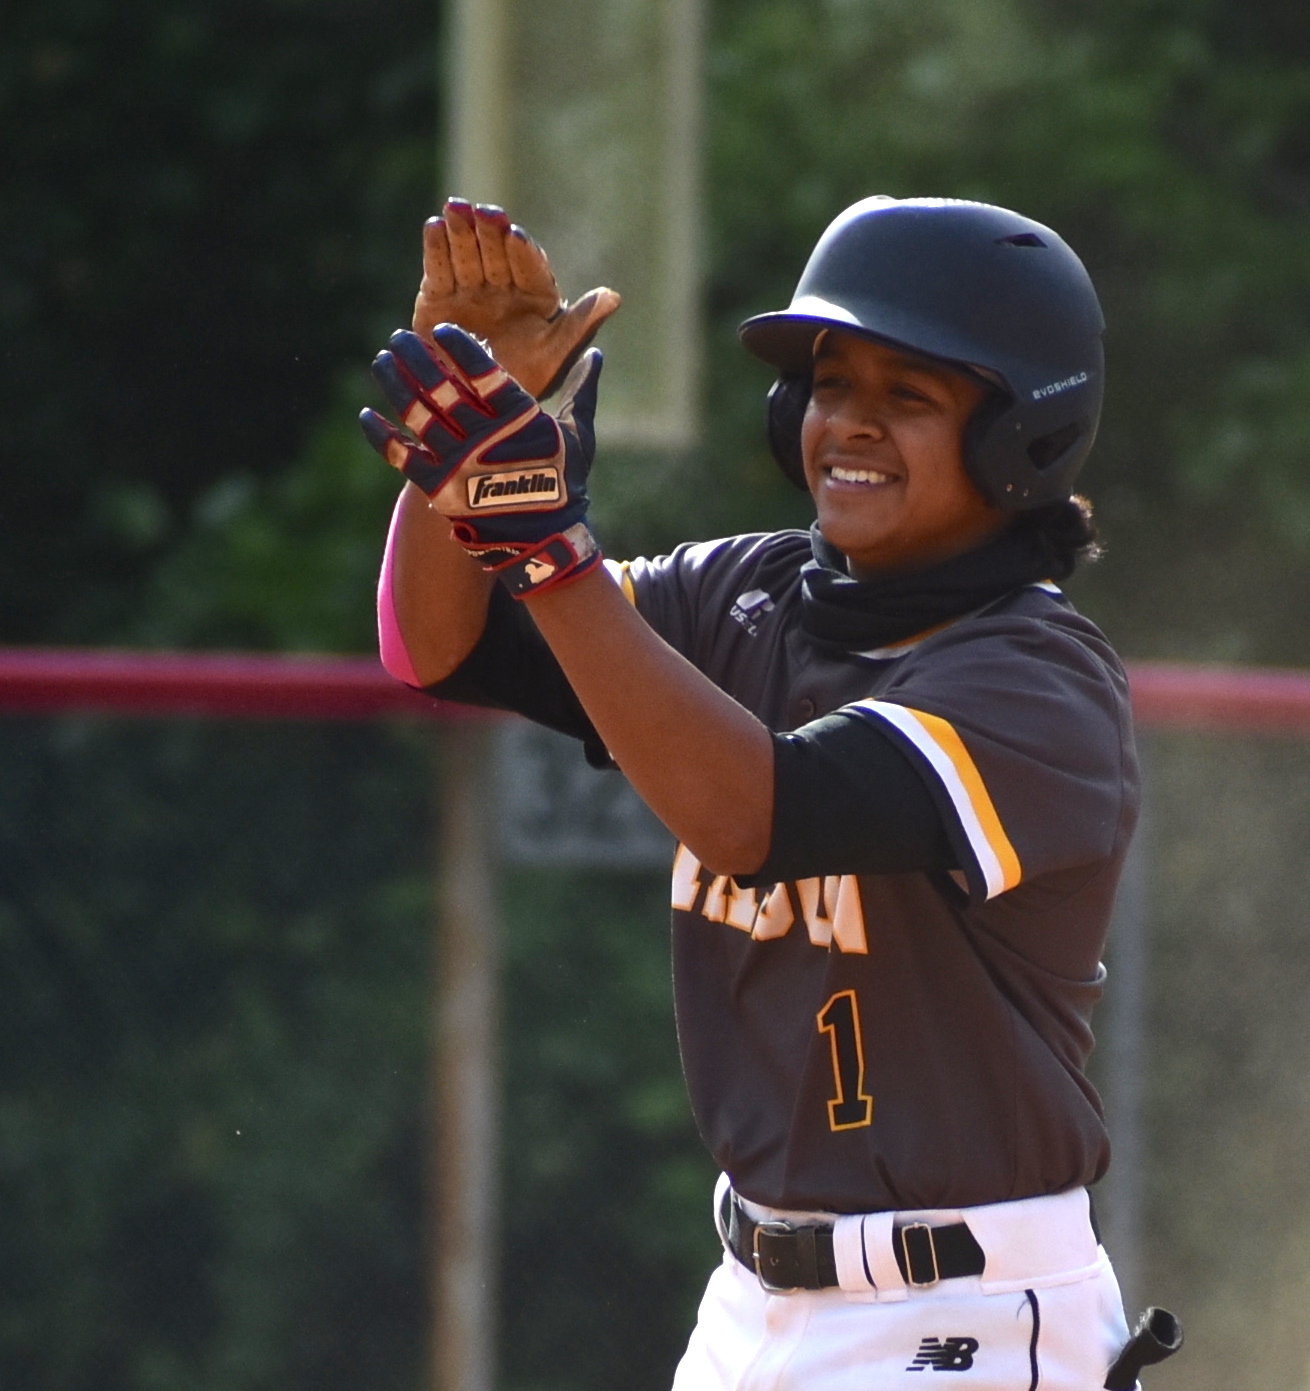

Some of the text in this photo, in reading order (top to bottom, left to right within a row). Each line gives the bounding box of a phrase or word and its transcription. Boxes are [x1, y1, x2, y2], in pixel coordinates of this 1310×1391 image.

[1032, 371, 1088, 400] EVOSHIELD
[472, 474, 557, 506] Franklin
[816, 988, 873, 1132] 1
[906, 1336, 979, 1372] NB
